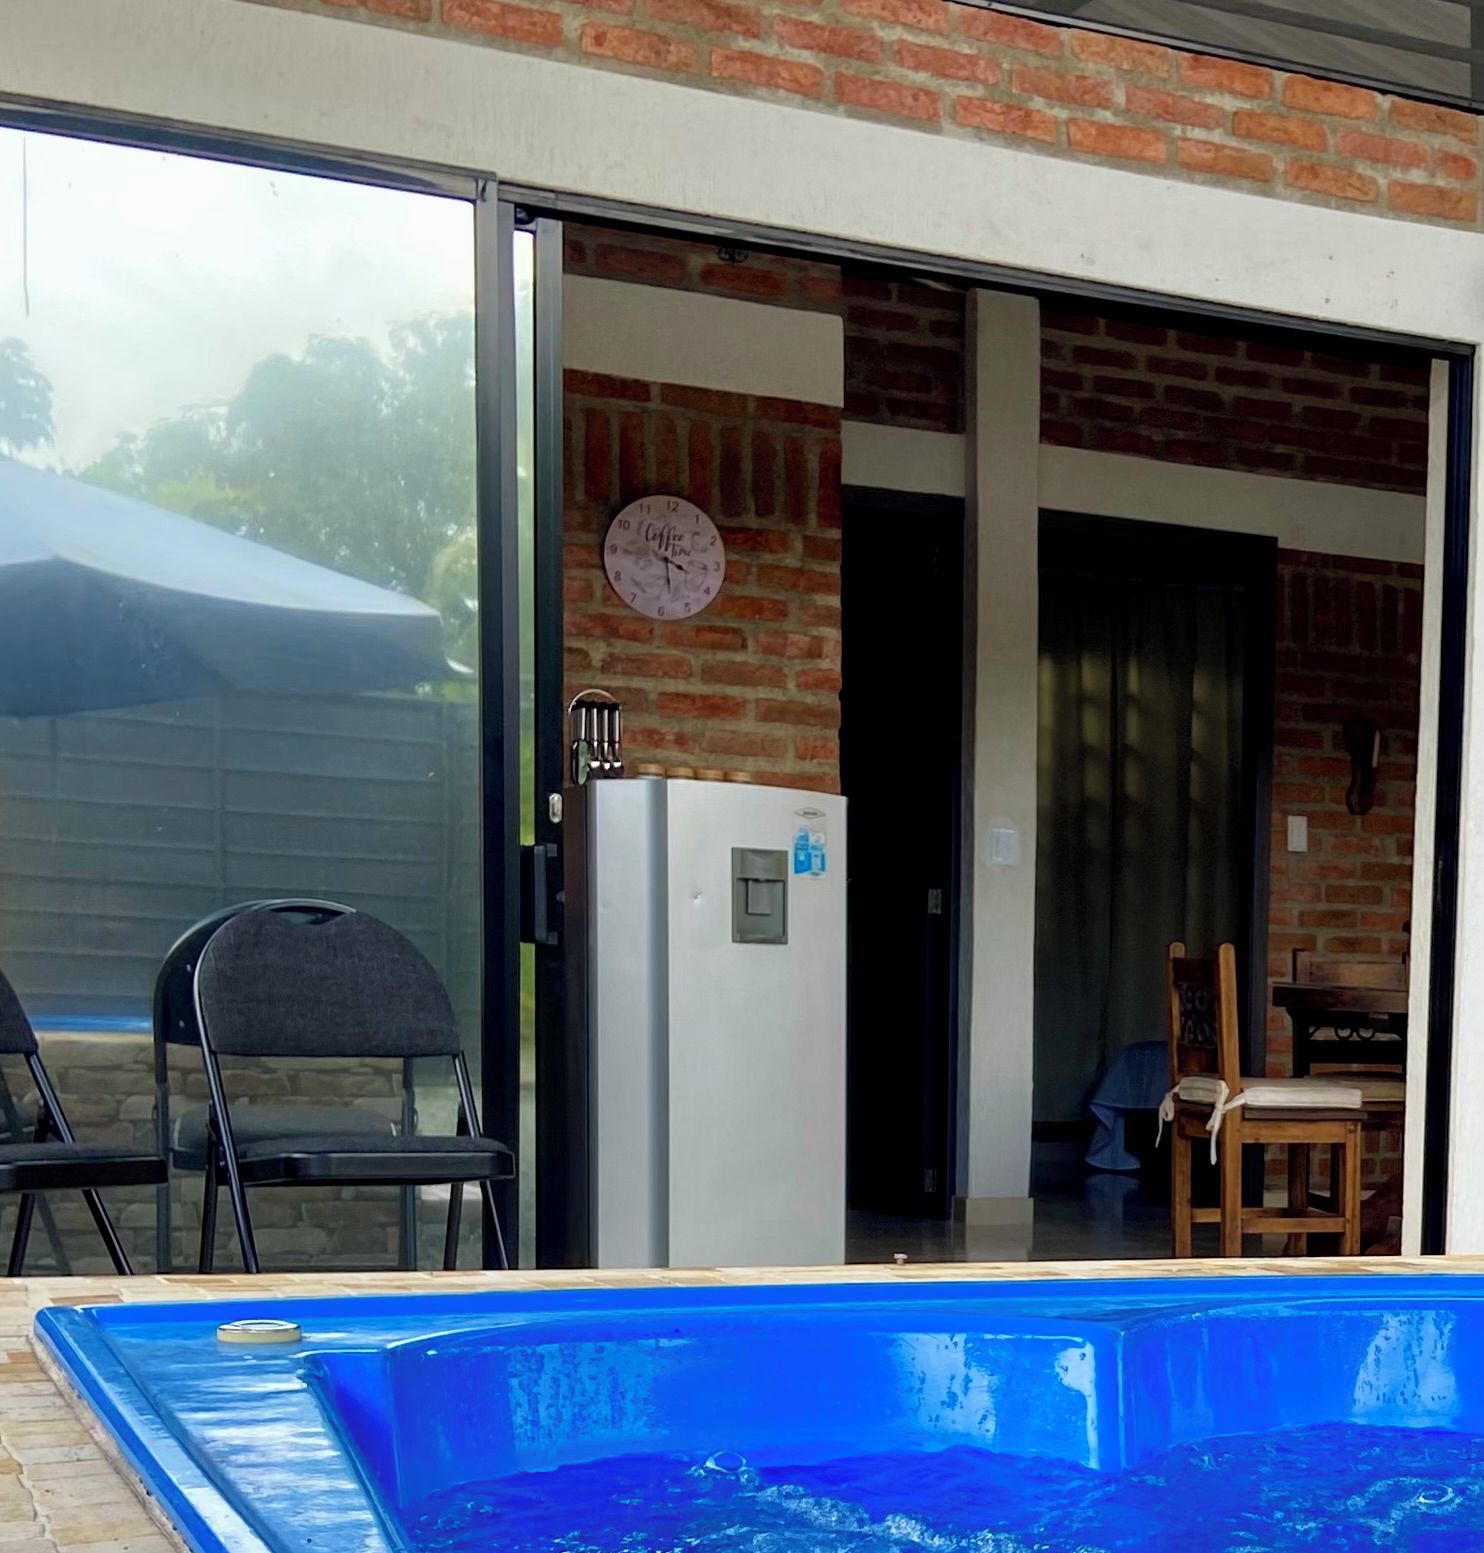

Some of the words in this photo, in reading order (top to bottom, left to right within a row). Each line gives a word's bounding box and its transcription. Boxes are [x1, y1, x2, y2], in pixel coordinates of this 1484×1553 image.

[639, 504, 651, 514] 11
[666, 501, 679, 512] 12
[618, 520, 630, 530] 10
[645, 523, 684, 552] Coffee
[709, 536, 717, 546] 2
[610, 544, 617, 554] 9
[671, 544, 692, 557] Time
[714, 562, 720, 572] 3
[614, 571, 621, 581] 8
[704, 587, 711, 595] 4
[658, 607, 664, 616] 6
[684, 603, 691, 613] 5
